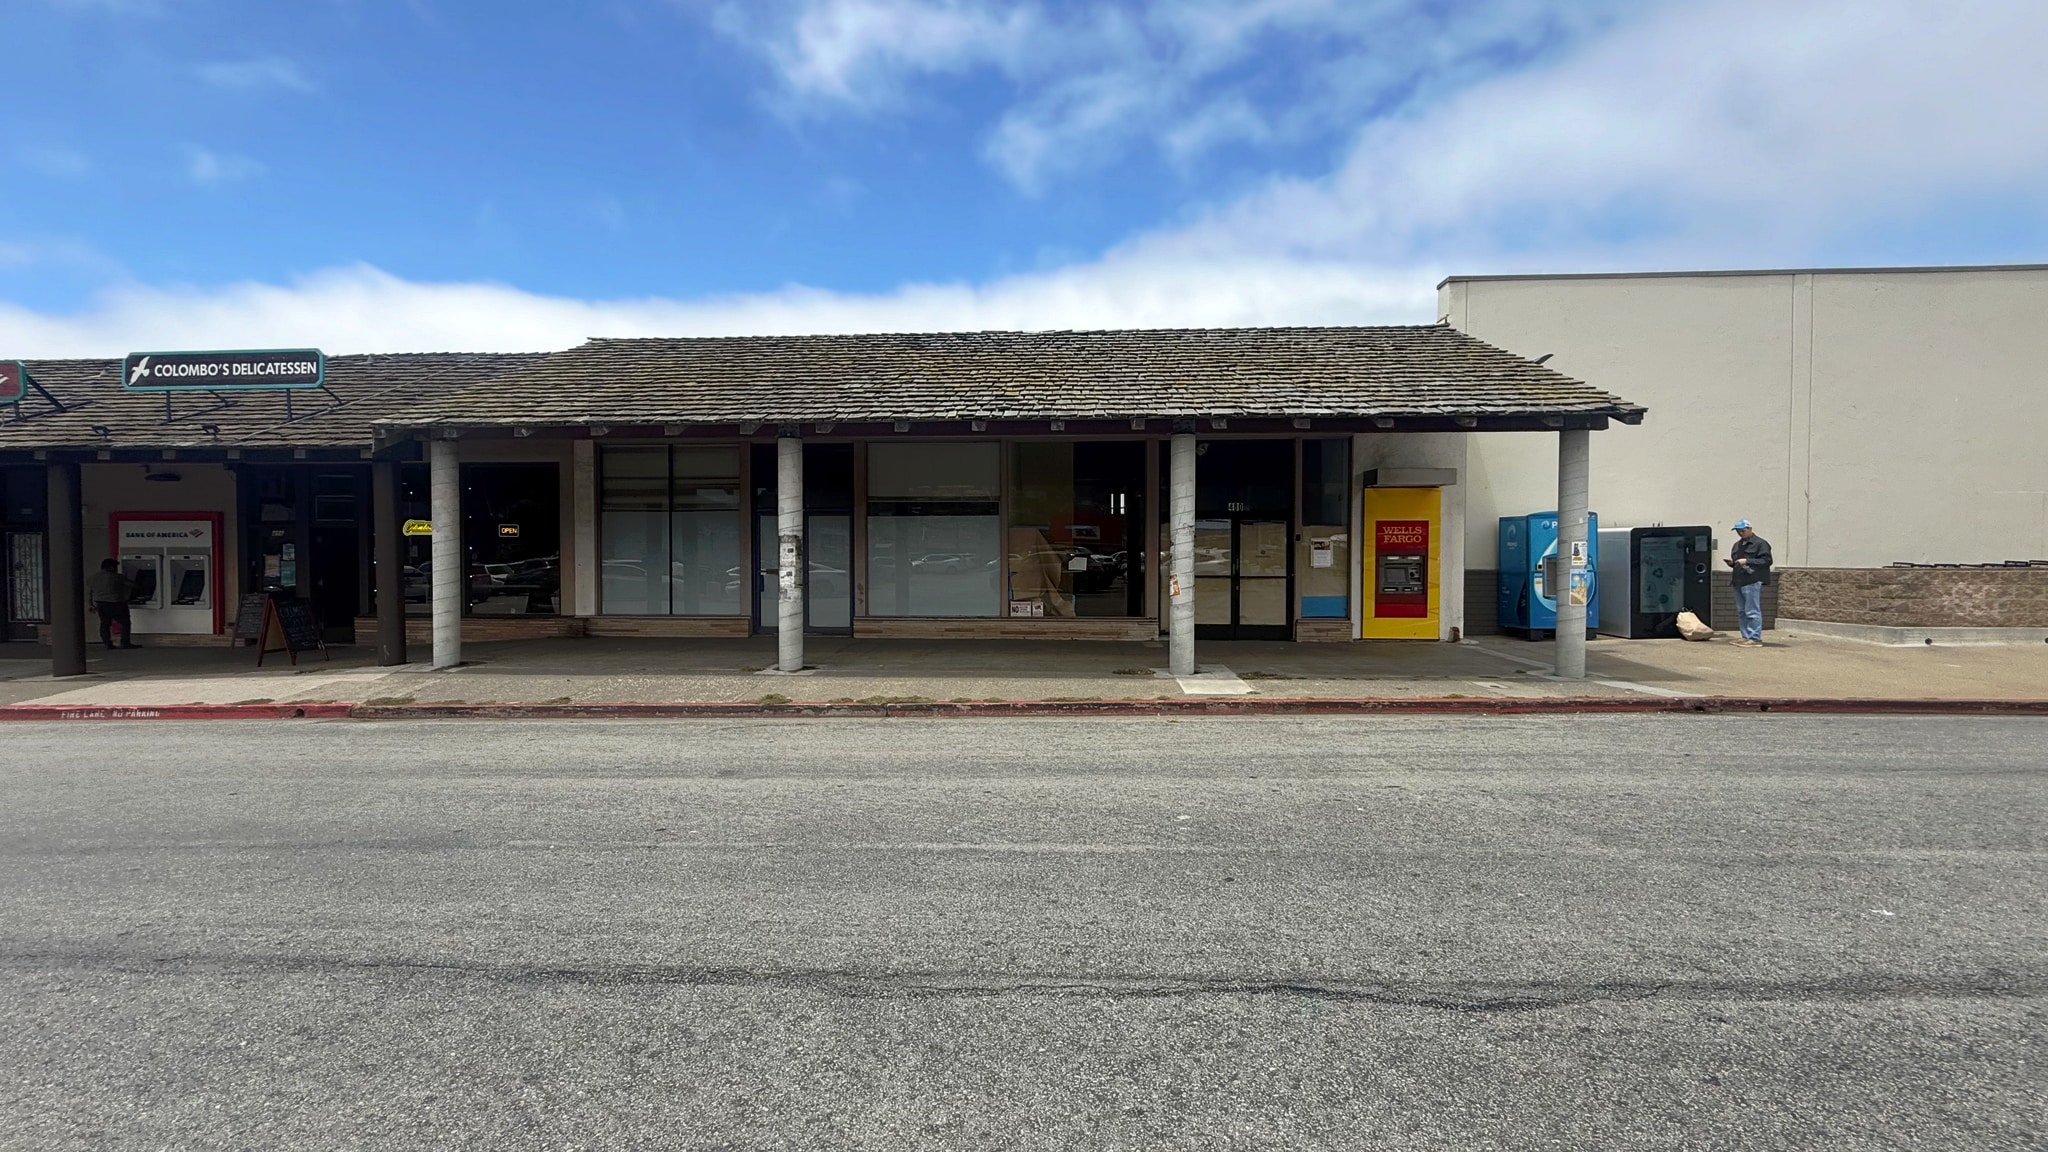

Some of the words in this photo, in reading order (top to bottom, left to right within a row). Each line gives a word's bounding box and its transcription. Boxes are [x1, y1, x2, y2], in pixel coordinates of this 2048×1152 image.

[155, 363, 229, 377] COLOMBO'S
[233, 361, 317, 376] DELICATESSEN
[1382, 526, 1422, 535] WELLS
[1383, 535, 1422, 543] FARGO
[61, 711, 80, 719] FIRE
[84, 710, 105, 718] LANE
[126, 709, 160, 718] PARKING
